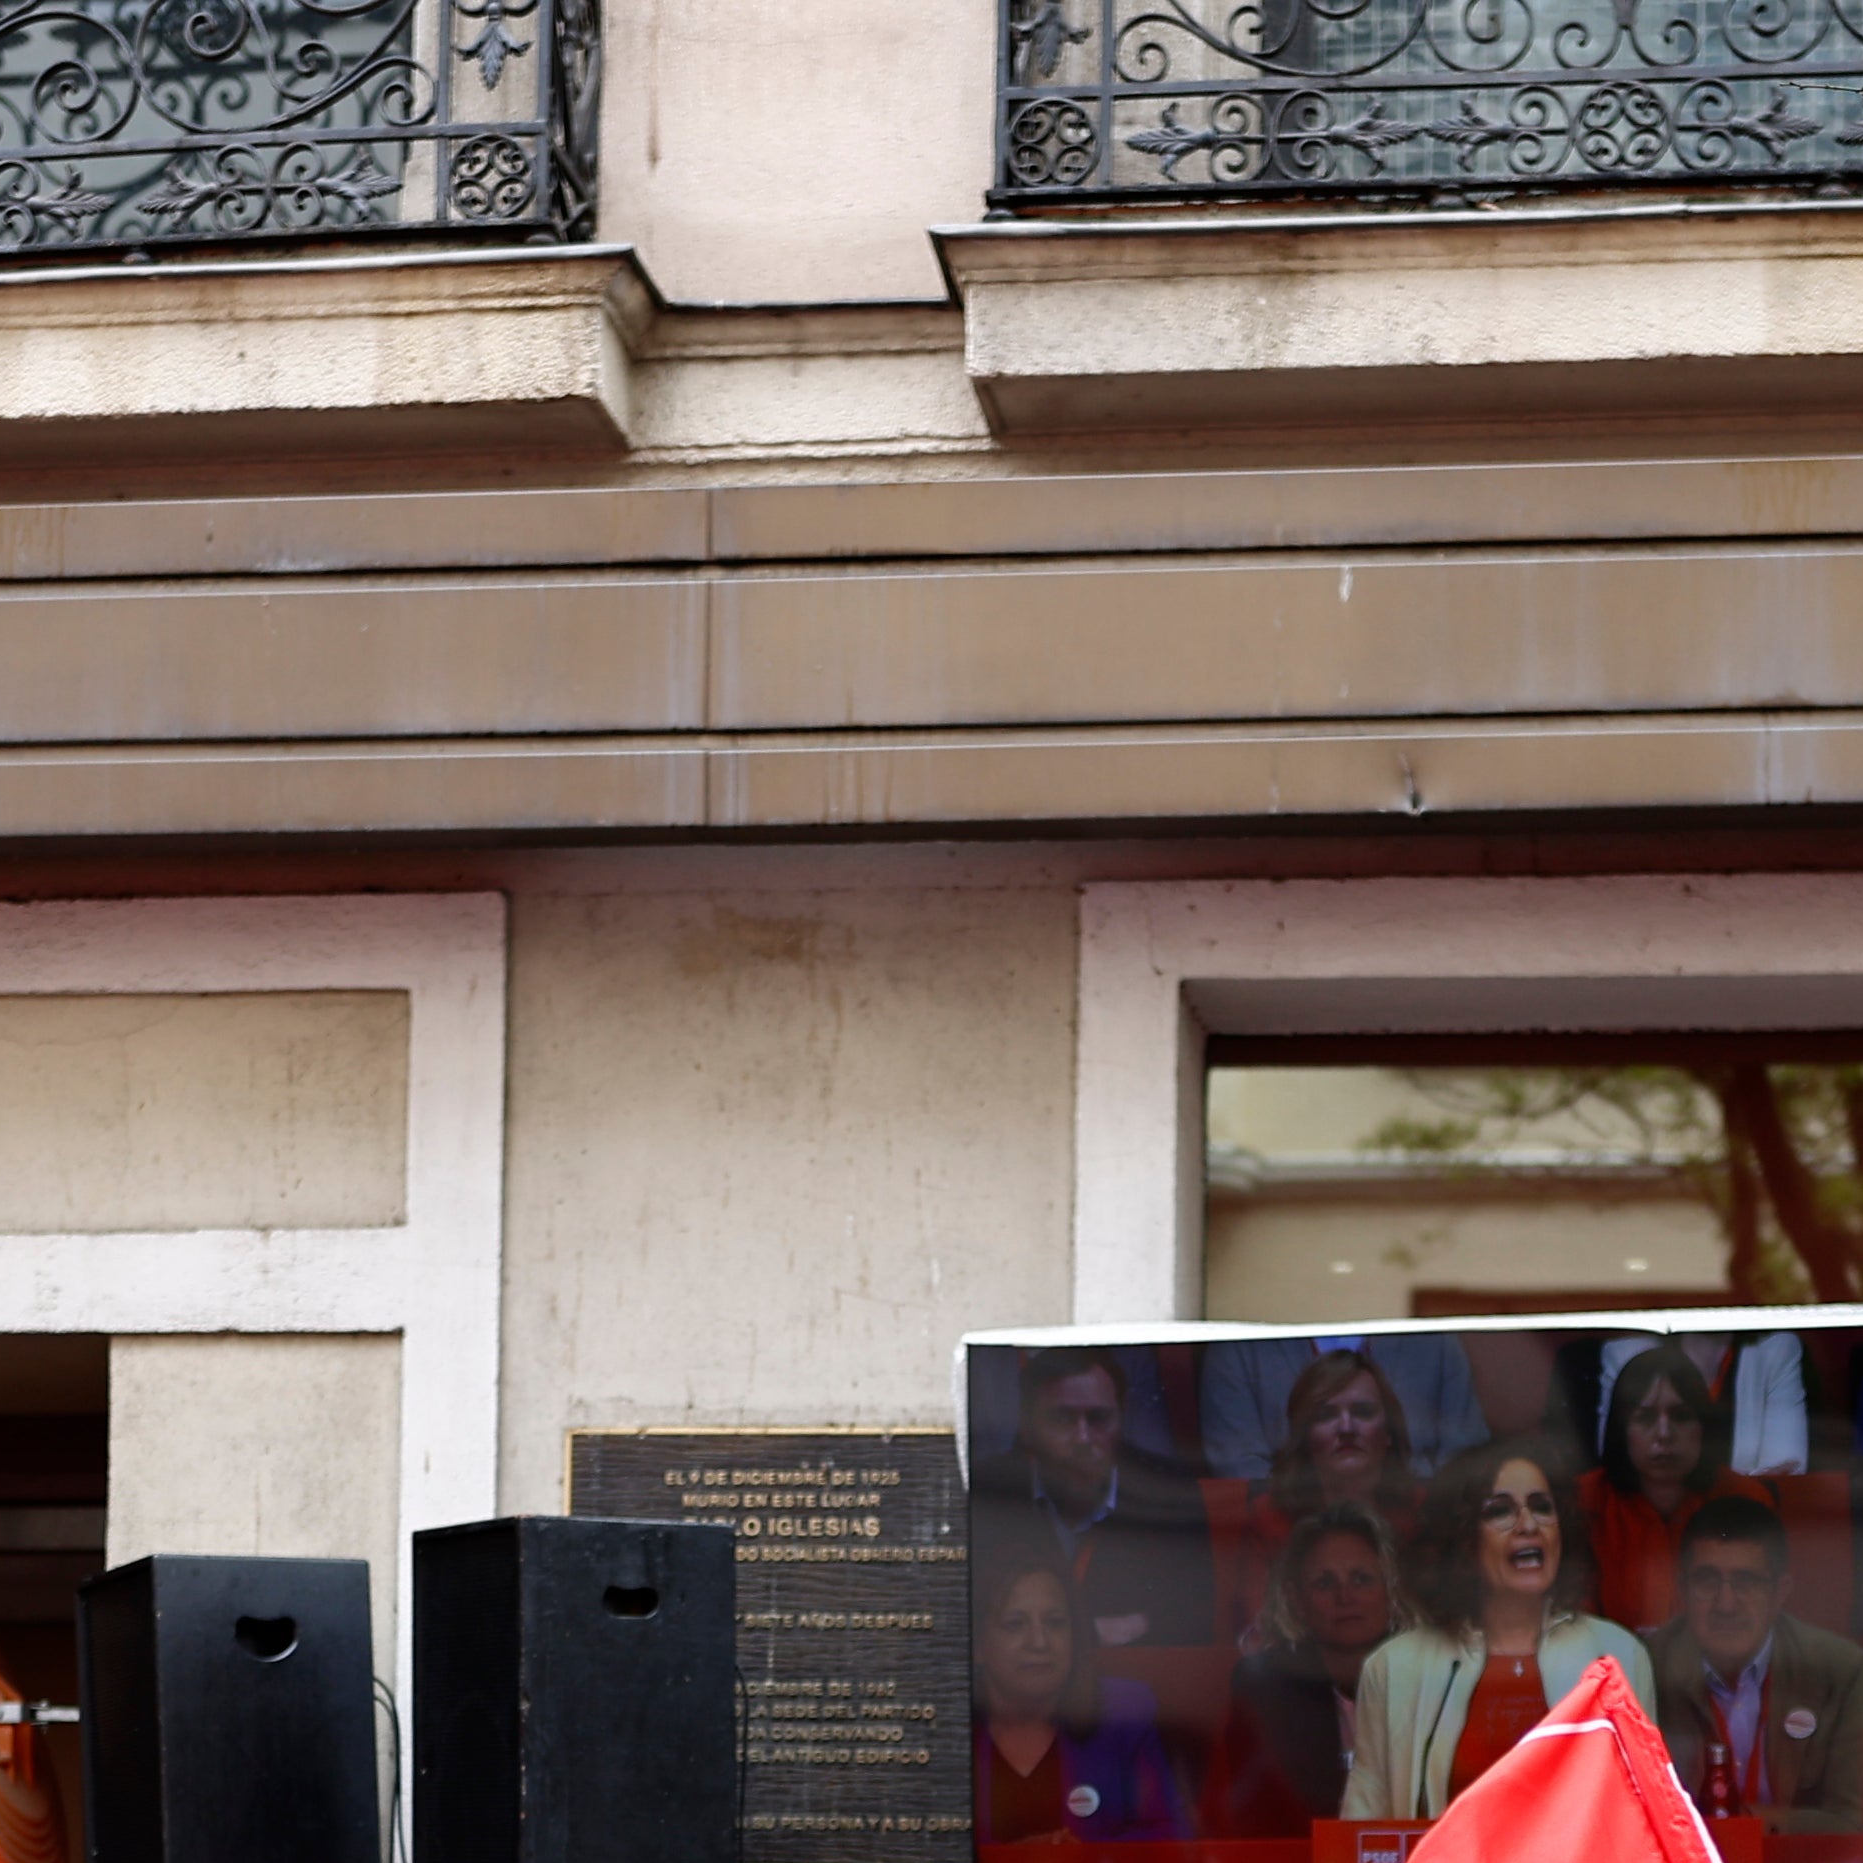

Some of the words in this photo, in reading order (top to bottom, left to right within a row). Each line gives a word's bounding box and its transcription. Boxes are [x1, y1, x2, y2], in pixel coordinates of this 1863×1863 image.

[663, 1469, 686, 1486] EL
[703, 1469, 728, 1486] DE
[831, 1469, 856, 1486] DE
[743, 1491, 768, 1508] EN
[771, 1491, 817, 1508] ESTE
[767, 1515, 881, 1537] IGLESIAS
